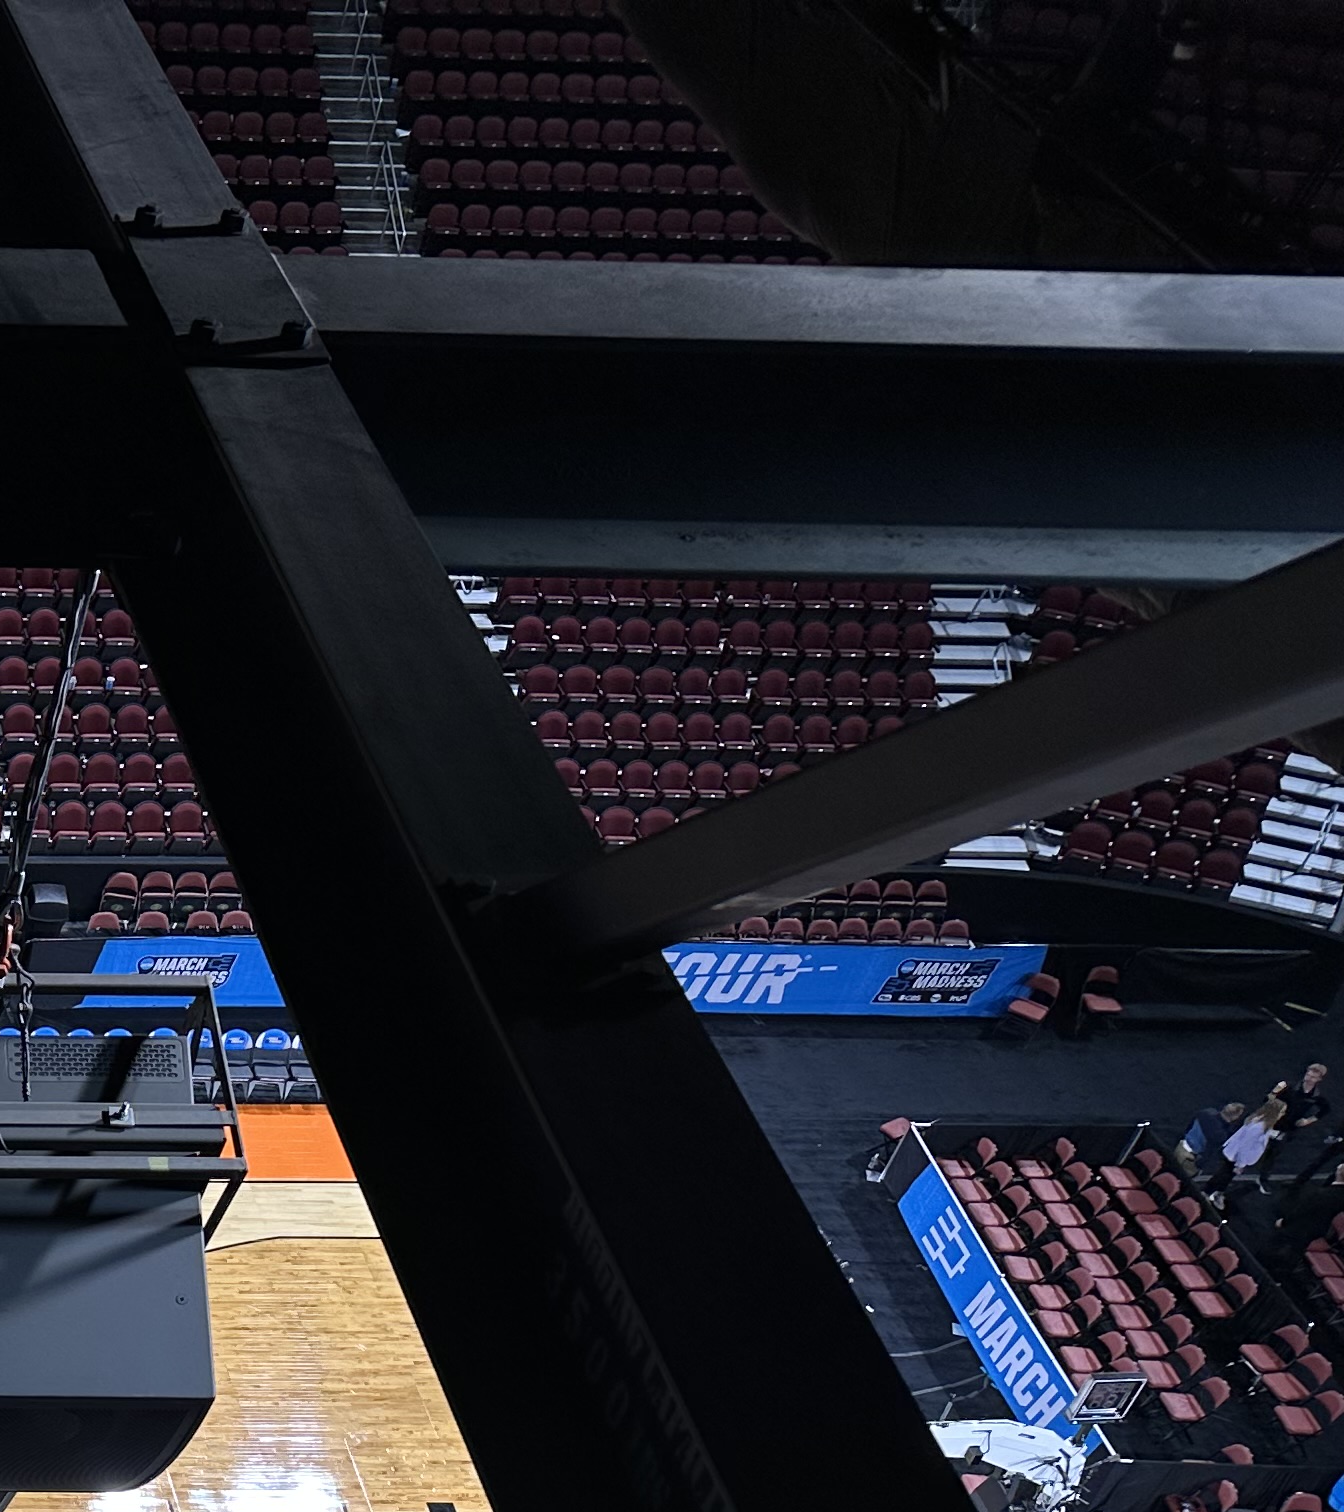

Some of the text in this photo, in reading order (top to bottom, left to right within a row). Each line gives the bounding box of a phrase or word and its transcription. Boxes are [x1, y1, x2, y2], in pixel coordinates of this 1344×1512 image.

[153, 958, 208, 970] MARCH
[912, 962, 971, 975] MARCH
[912, 975, 988, 988] MADNESS
[963, 1281, 1066, 1427] MARCH
